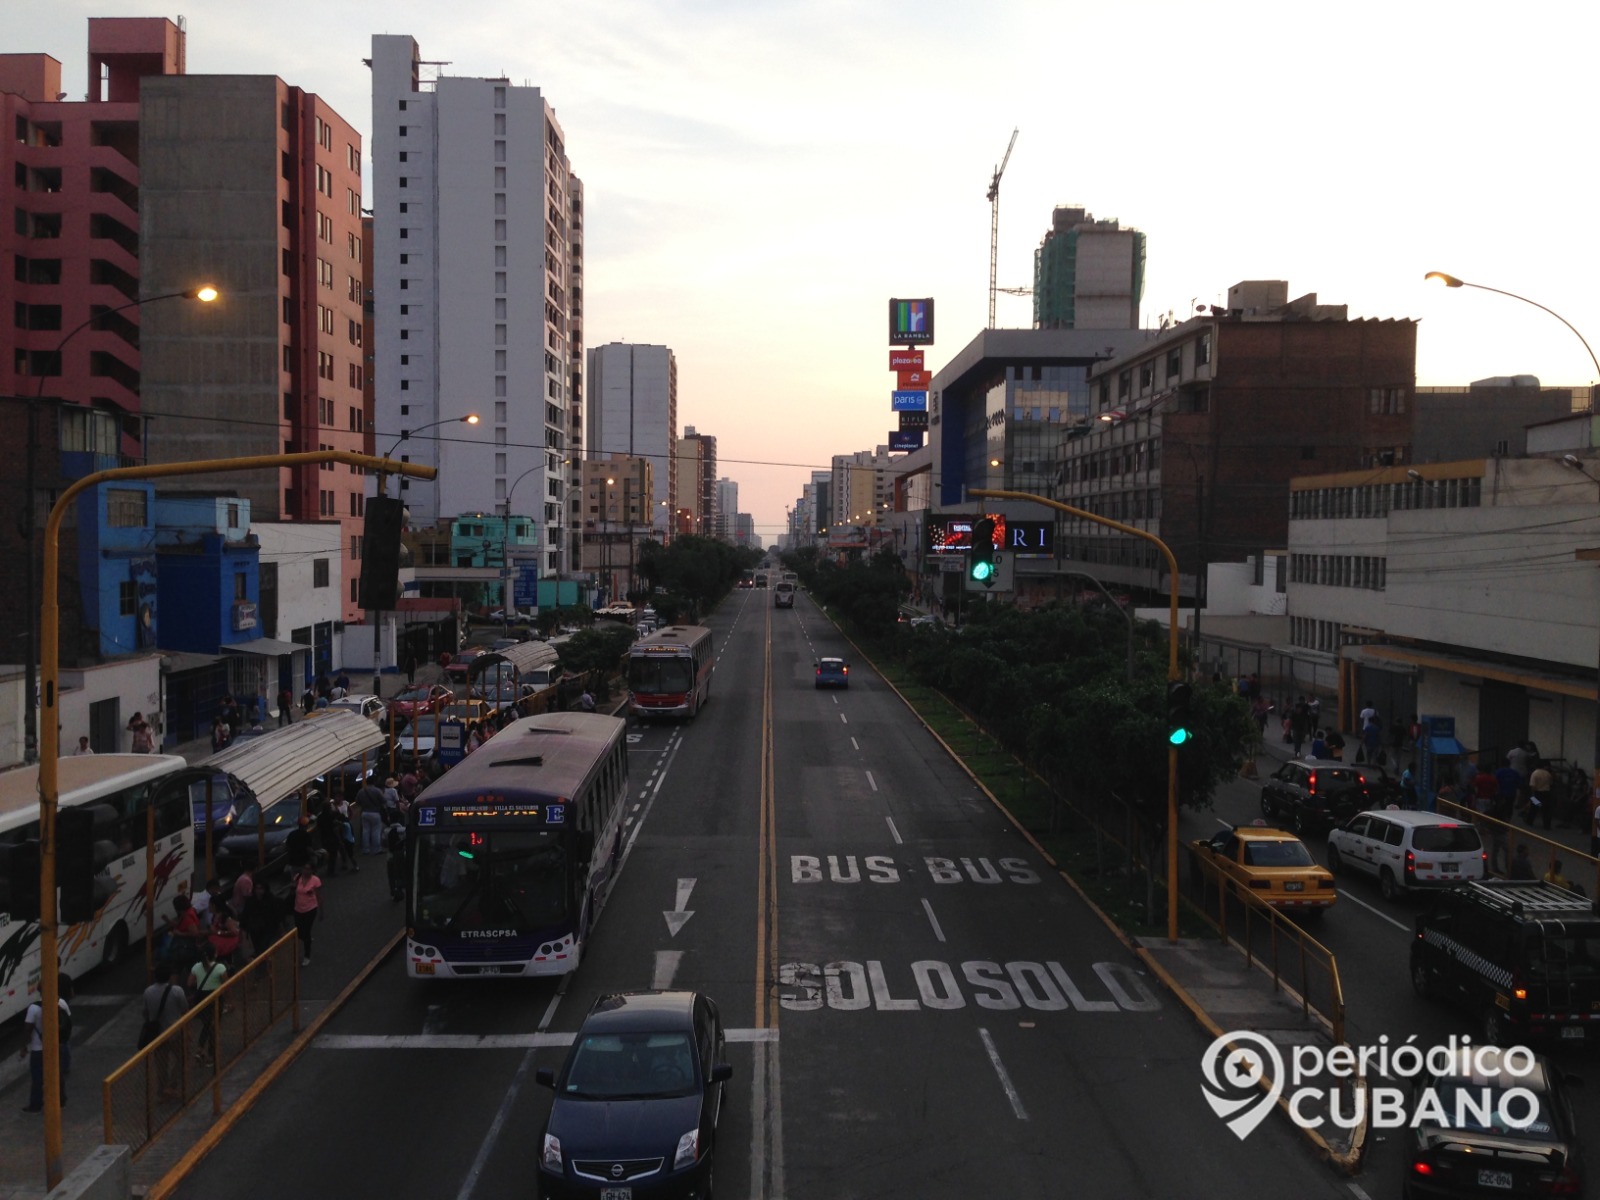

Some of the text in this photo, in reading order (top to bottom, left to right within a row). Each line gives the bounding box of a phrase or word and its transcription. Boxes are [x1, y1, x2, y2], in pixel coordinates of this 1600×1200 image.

[894, 394, 915, 406] paris
[418, 807, 436, 826] E
[545, 805, 565, 824] E
[791, 855, 901, 883] BUS
[922, 857, 1043, 885] BUS
[460, 929, 518, 938] ETRASCPSA
[779, 960, 966, 1011] SOLO
[959, 960, 1163, 1012] SOLO
